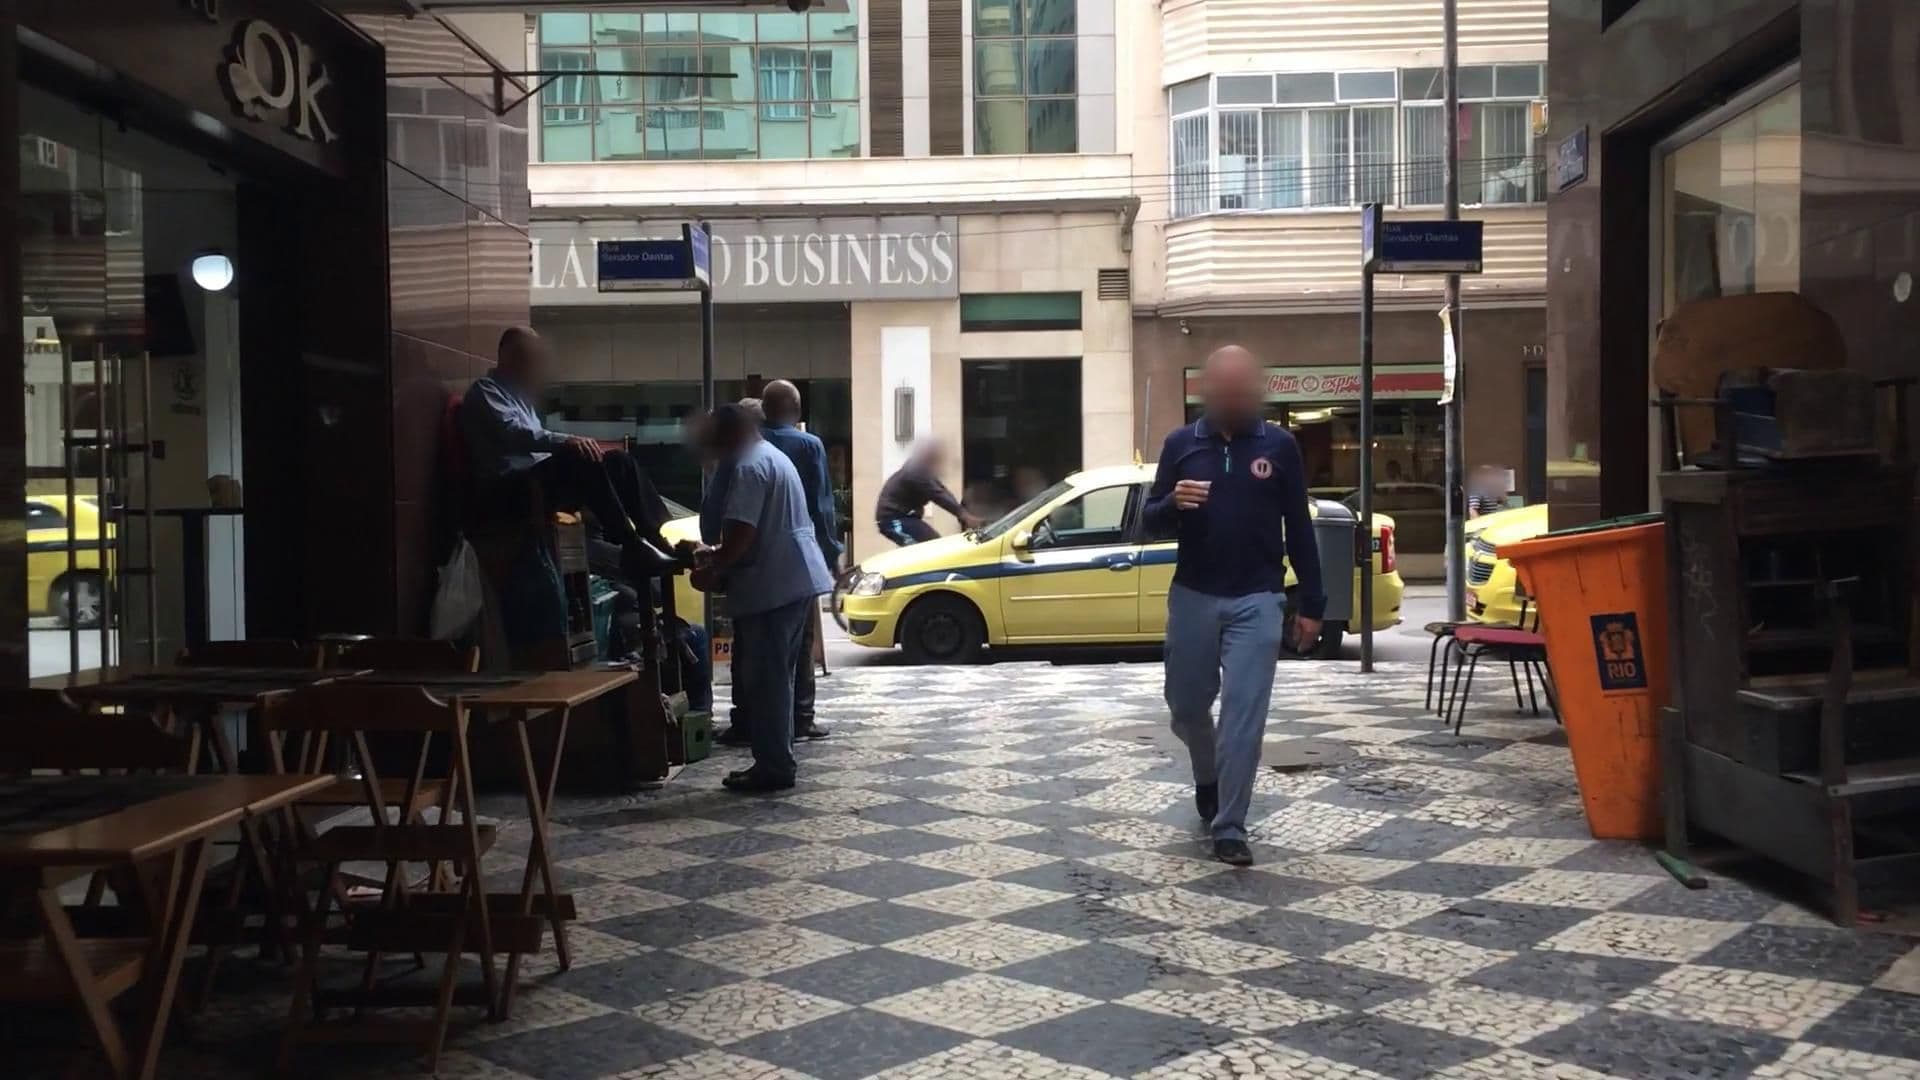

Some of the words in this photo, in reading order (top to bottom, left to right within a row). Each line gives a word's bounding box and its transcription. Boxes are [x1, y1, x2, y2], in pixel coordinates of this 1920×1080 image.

[230, 18, 339, 144] OK
[1382, 232, 1423, 243] Senador
[1424, 232, 1459, 243] Dantas
[602, 242, 619, 252] Rua
[601, 251, 640, 262] Senador
[641, 251, 674, 262] Dantas
[743, 231, 953, 287] BUSINESS
[1608, 662, 1636, 678] RIO
